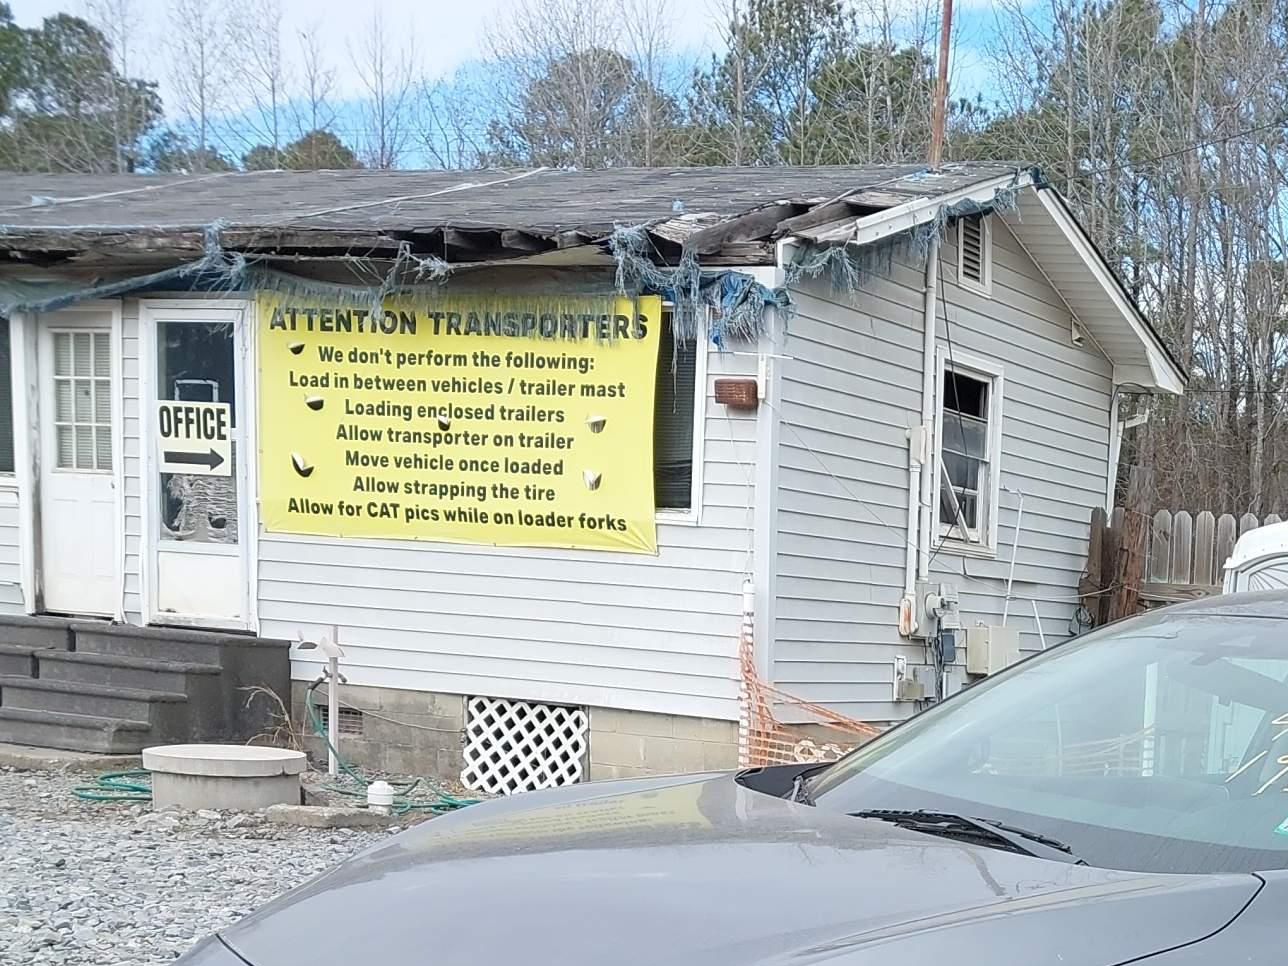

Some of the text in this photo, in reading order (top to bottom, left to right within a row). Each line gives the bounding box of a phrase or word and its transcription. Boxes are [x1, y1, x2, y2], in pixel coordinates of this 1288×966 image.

[269, 307, 649, 340] ATTENTION TRANSPORTERS
[318, 346, 594, 374] We don't perform the following:
[289, 371, 626, 398] Load in between vehicles / trailer mast
[159, 405, 227, 441] OFFICE
[345, 399, 565, 423] Loading enclosed trailers
[336, 424, 574, 449] Allow transporter on trailer
[345, 450, 564, 476] Move vehicle once loaded
[353, 476, 555, 502] Allow strapping the tire
[288, 498, 627, 531] Allow for CAT pics while on loader forks
